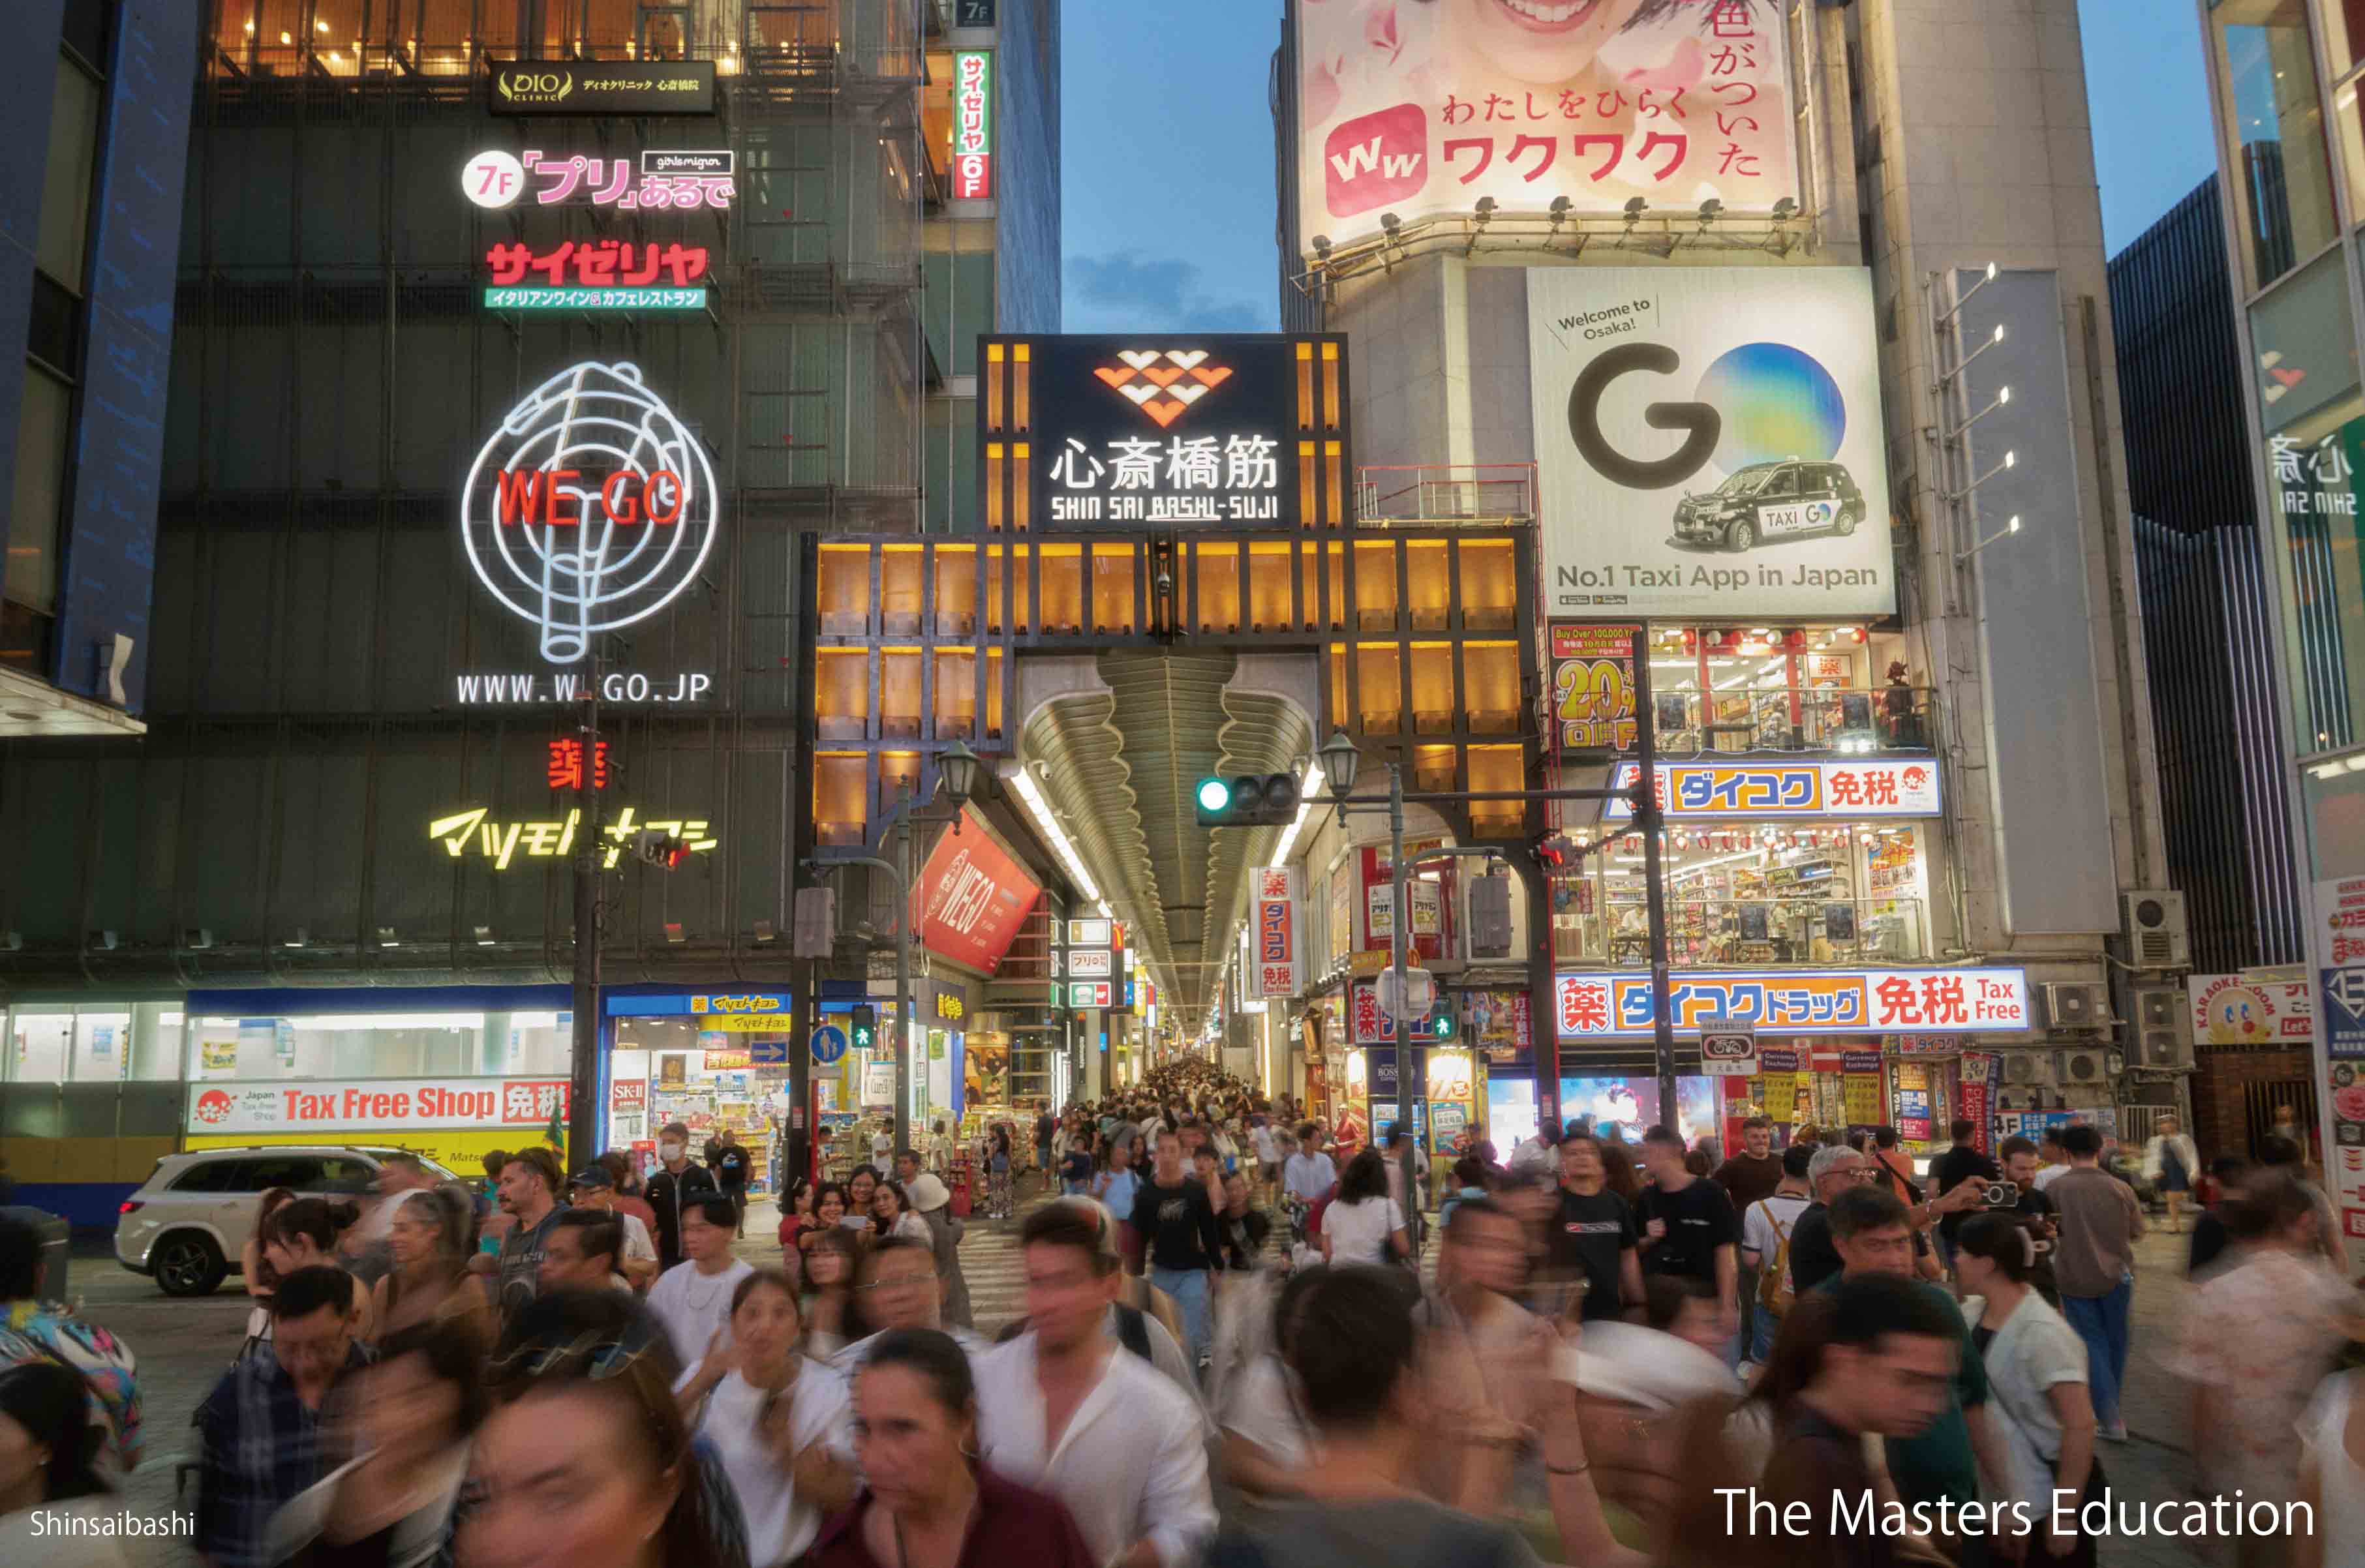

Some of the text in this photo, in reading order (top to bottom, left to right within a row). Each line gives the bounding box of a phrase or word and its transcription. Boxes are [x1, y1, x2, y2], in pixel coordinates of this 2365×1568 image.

[513, 74, 559, 92] DIO
[583, 80, 652, 91] ディオクリニック
[964, 57, 983, 149] サイゼリヤ
[1442, 87, 1688, 126] わたしをひらく
[1442, 132, 1688, 184] ワクワク
[477, 165, 513, 195] 7F
[962, 156, 983, 198] 6F
[485, 240, 708, 287] サイゼリヤ
[1558, 299, 1650, 330] Welcome to
[1583, 318, 1636, 340] Osaka!
[1050, 434, 1279, 490] 心斎橋筋
[498, 469, 684, 526] WE GO
[1052, 496, 1101, 520] SHIN
[1109, 496, 1143, 520] SAI
[1767, 511, 1797, 527] TAXI
[1557, 564, 1878, 591] No.1 Taxi App in Japan
[1556, 629, 1570, 639] Buy
[457, 674, 710, 703] WWW.WGO.JP
[549, 739, 607, 789] 薬
[1681, 772, 1812, 807] ダイコク
[1829, 770, 1899, 806] 免税
[1263, 870, 1287, 896] 薬
[1266, 903, 1285, 961] ダイコク
[1263, 967, 1291, 985] 免税
[1977, 978, 2013, 999] Tax
[712, 995, 780, 1012] マツモトキヨシ
[1357, 986, 1376, 1040] 薬
[1564, 978, 1608, 1029] 薬
[1622, 983, 1859, 1025] ダイコクドラッグ
[1876, 976, 1968, 1025] 免税
[1976, 1001, 2021, 1019] Free
[734, 1017, 788, 1029] マツモトキヨシ
[1377, 1068, 1399, 1077] BOSS
[245, 1090, 275, 1101] Japan
[284, 1087, 496, 1121] Tax Free Shop
[615, 1085, 643, 1098] SK-II
